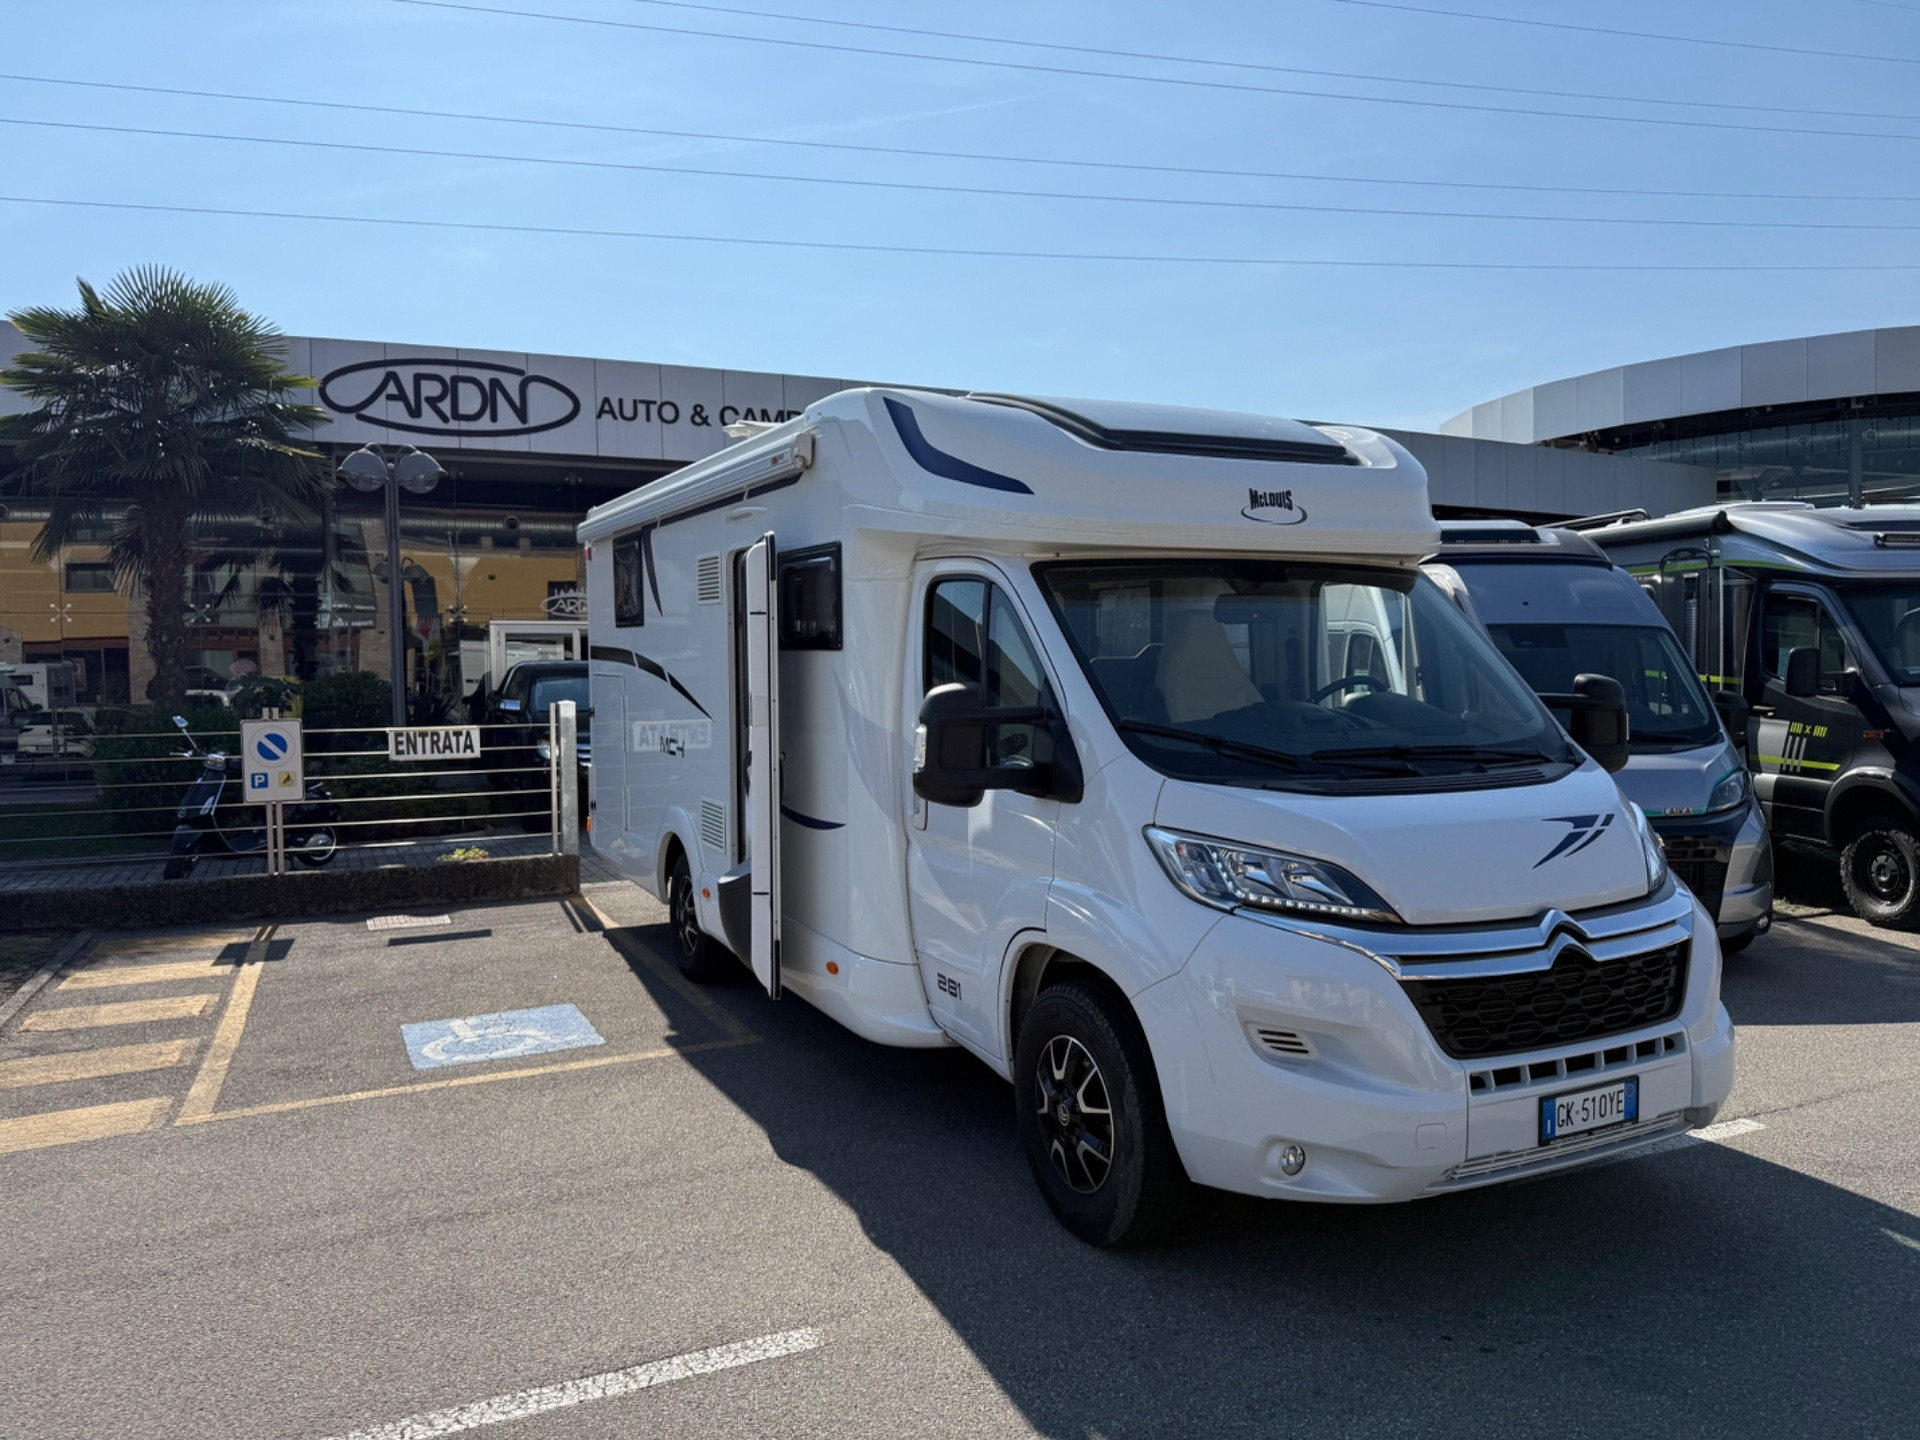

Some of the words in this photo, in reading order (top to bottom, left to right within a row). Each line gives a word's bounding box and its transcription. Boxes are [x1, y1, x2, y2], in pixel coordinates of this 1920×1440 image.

[596, 397, 680, 425] AUTO
[689, 404, 711, 427] &
[394, 730, 475, 755] ENTRATA
[254, 774, 266, 788] P
[937, 972, 962, 1001] 281
